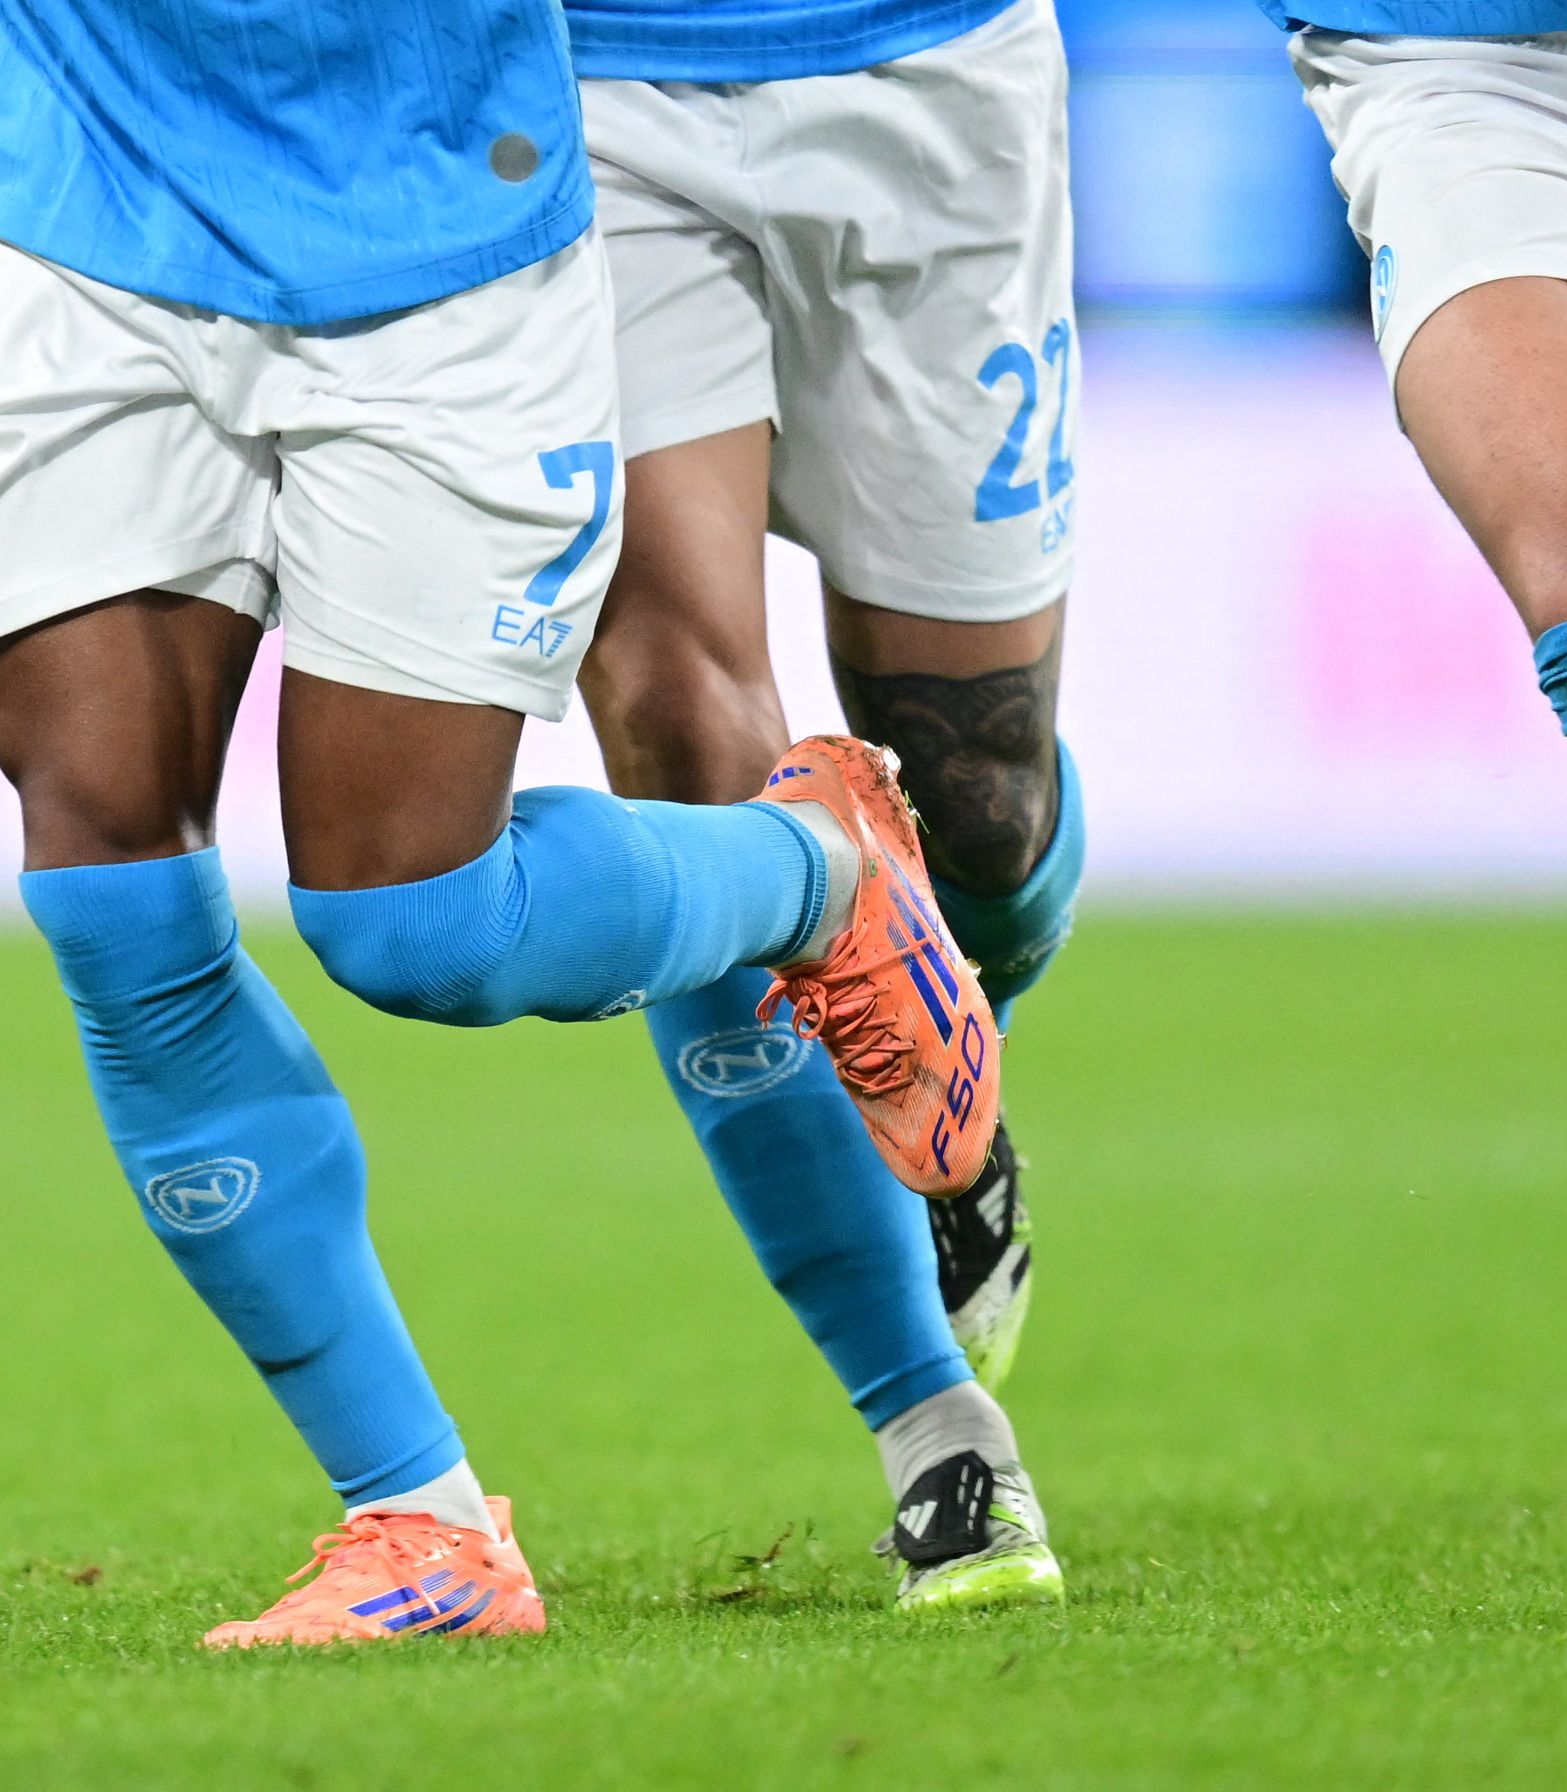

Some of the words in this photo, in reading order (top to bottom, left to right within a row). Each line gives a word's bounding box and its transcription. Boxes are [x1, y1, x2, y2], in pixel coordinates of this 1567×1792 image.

[975, 317, 1074, 523] 22
[524, 441, 613, 606] 7
[491, 604, 573, 658] EA7
[931, 1012, 985, 1178] F50
